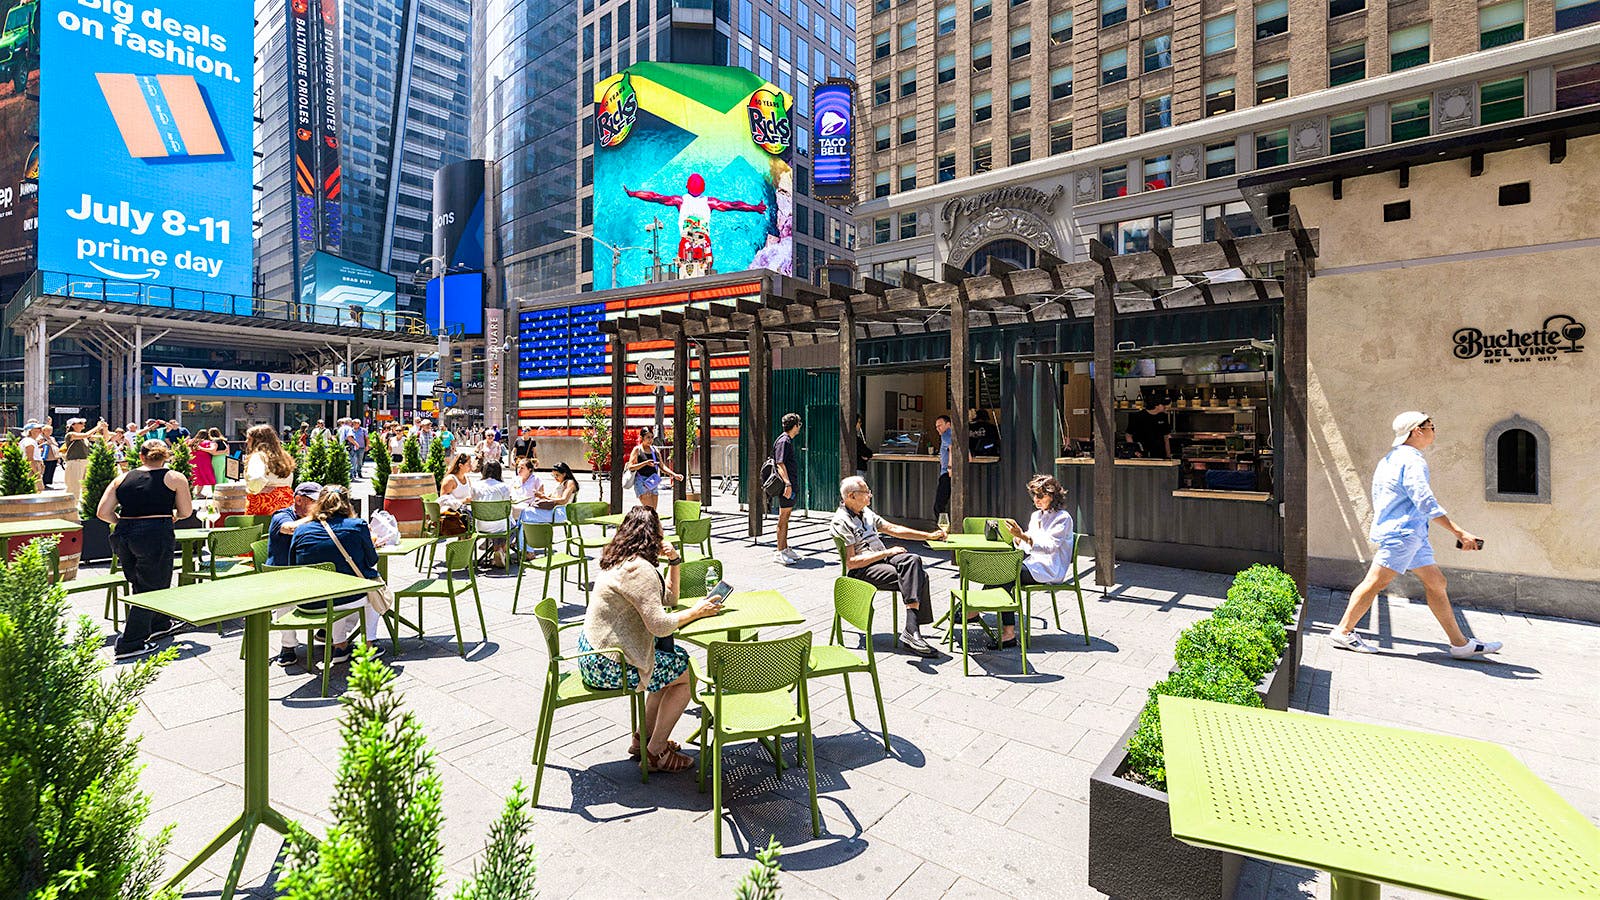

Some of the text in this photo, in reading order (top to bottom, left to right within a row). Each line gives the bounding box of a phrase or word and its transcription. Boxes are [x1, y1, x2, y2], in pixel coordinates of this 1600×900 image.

[57, 10, 241, 83] on fashion.
[141, 7, 227, 52] deals
[296, 17, 308, 77] BALTIMORE
[818, 138, 847, 147] TACO
[820, 146, 847, 156] BELL
[65, 193, 230, 244] July 8-11
[941, 184, 1064, 241] Paramount
[77, 238, 223, 278] prime day
[1453, 327, 1562, 359] Buchette
[1484, 346, 1558, 357] DEL VINO
[152, 367, 357, 394] NEW YORK POLICE DEPT
